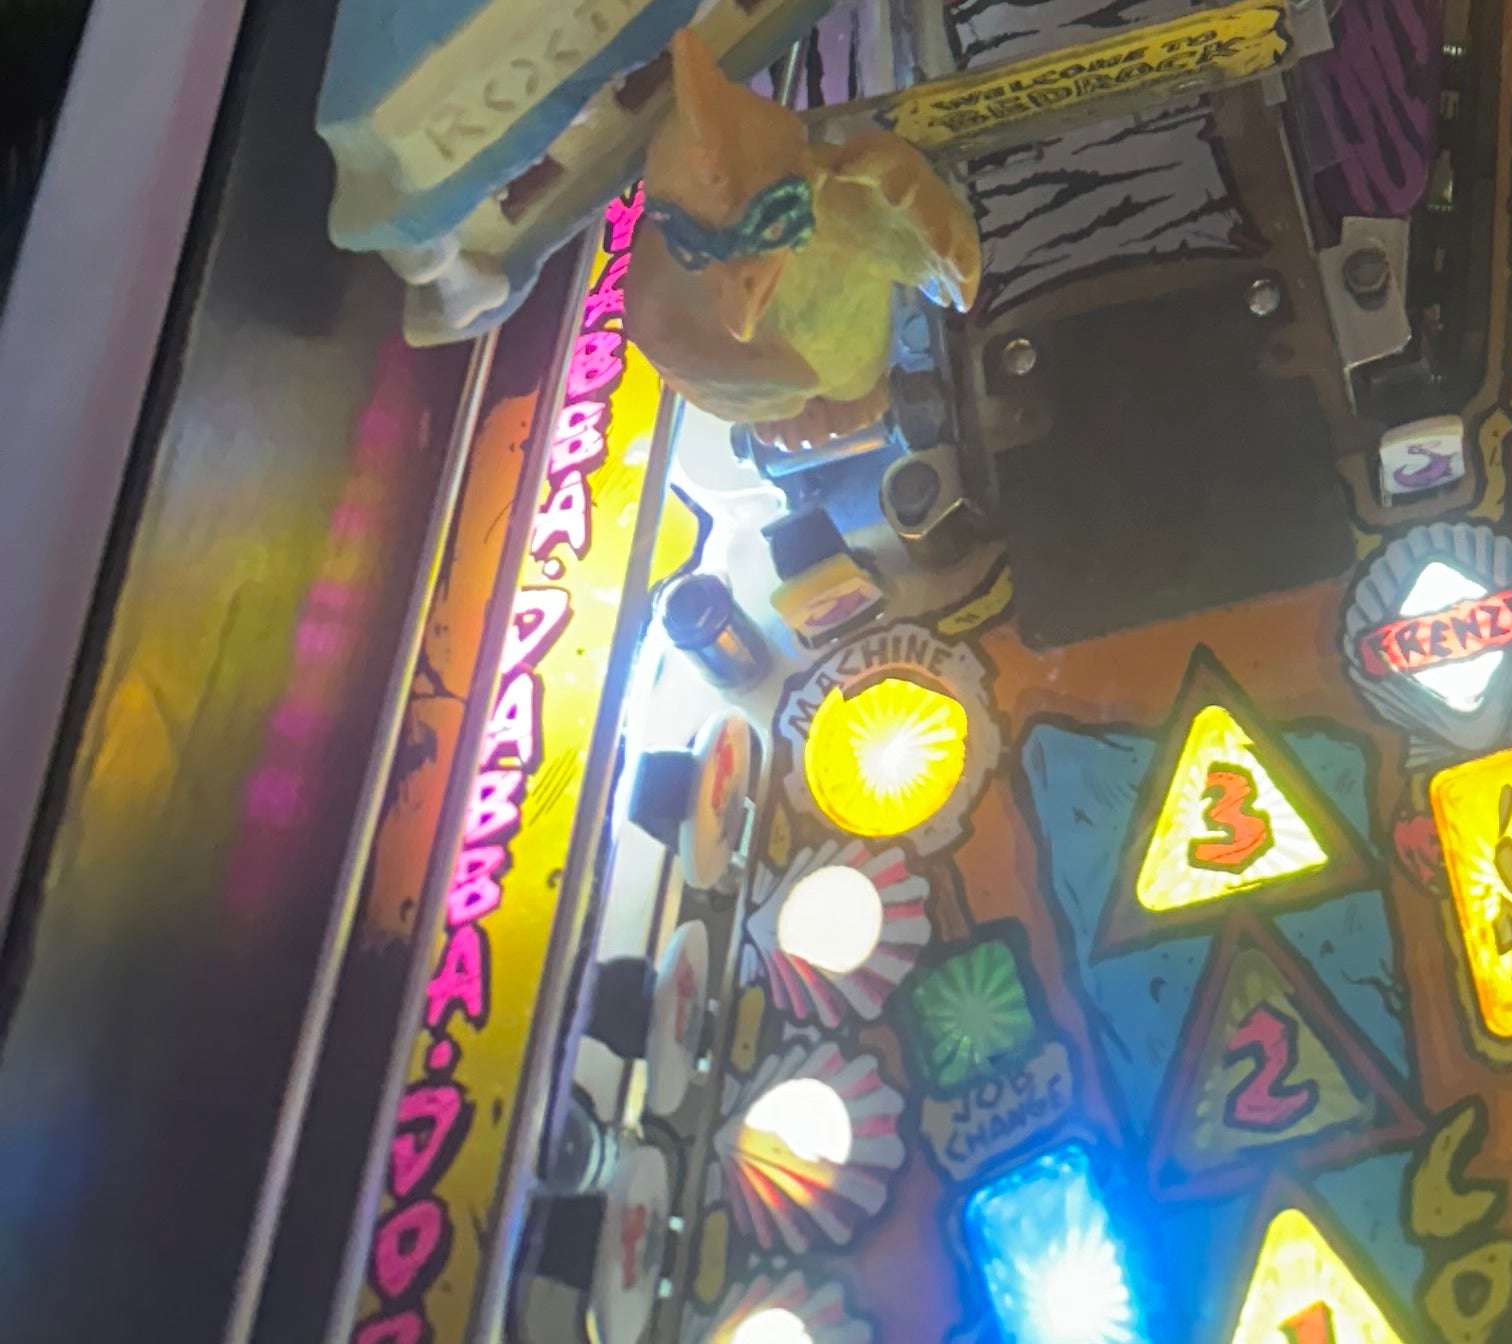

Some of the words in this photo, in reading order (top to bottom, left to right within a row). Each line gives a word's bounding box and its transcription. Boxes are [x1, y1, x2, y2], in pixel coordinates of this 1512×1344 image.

[930, 46, 1150, 111] WELCOME
[1160, 29, 1219, 54] TO
[936, 36, 1246, 134] BEDROCK
[793, 632, 954, 740] MACHINE
[1188, 760, 1275, 876] 3
[1223, 1000, 1322, 1132] 2
[943, 1072, 1070, 1168] CHANGE
